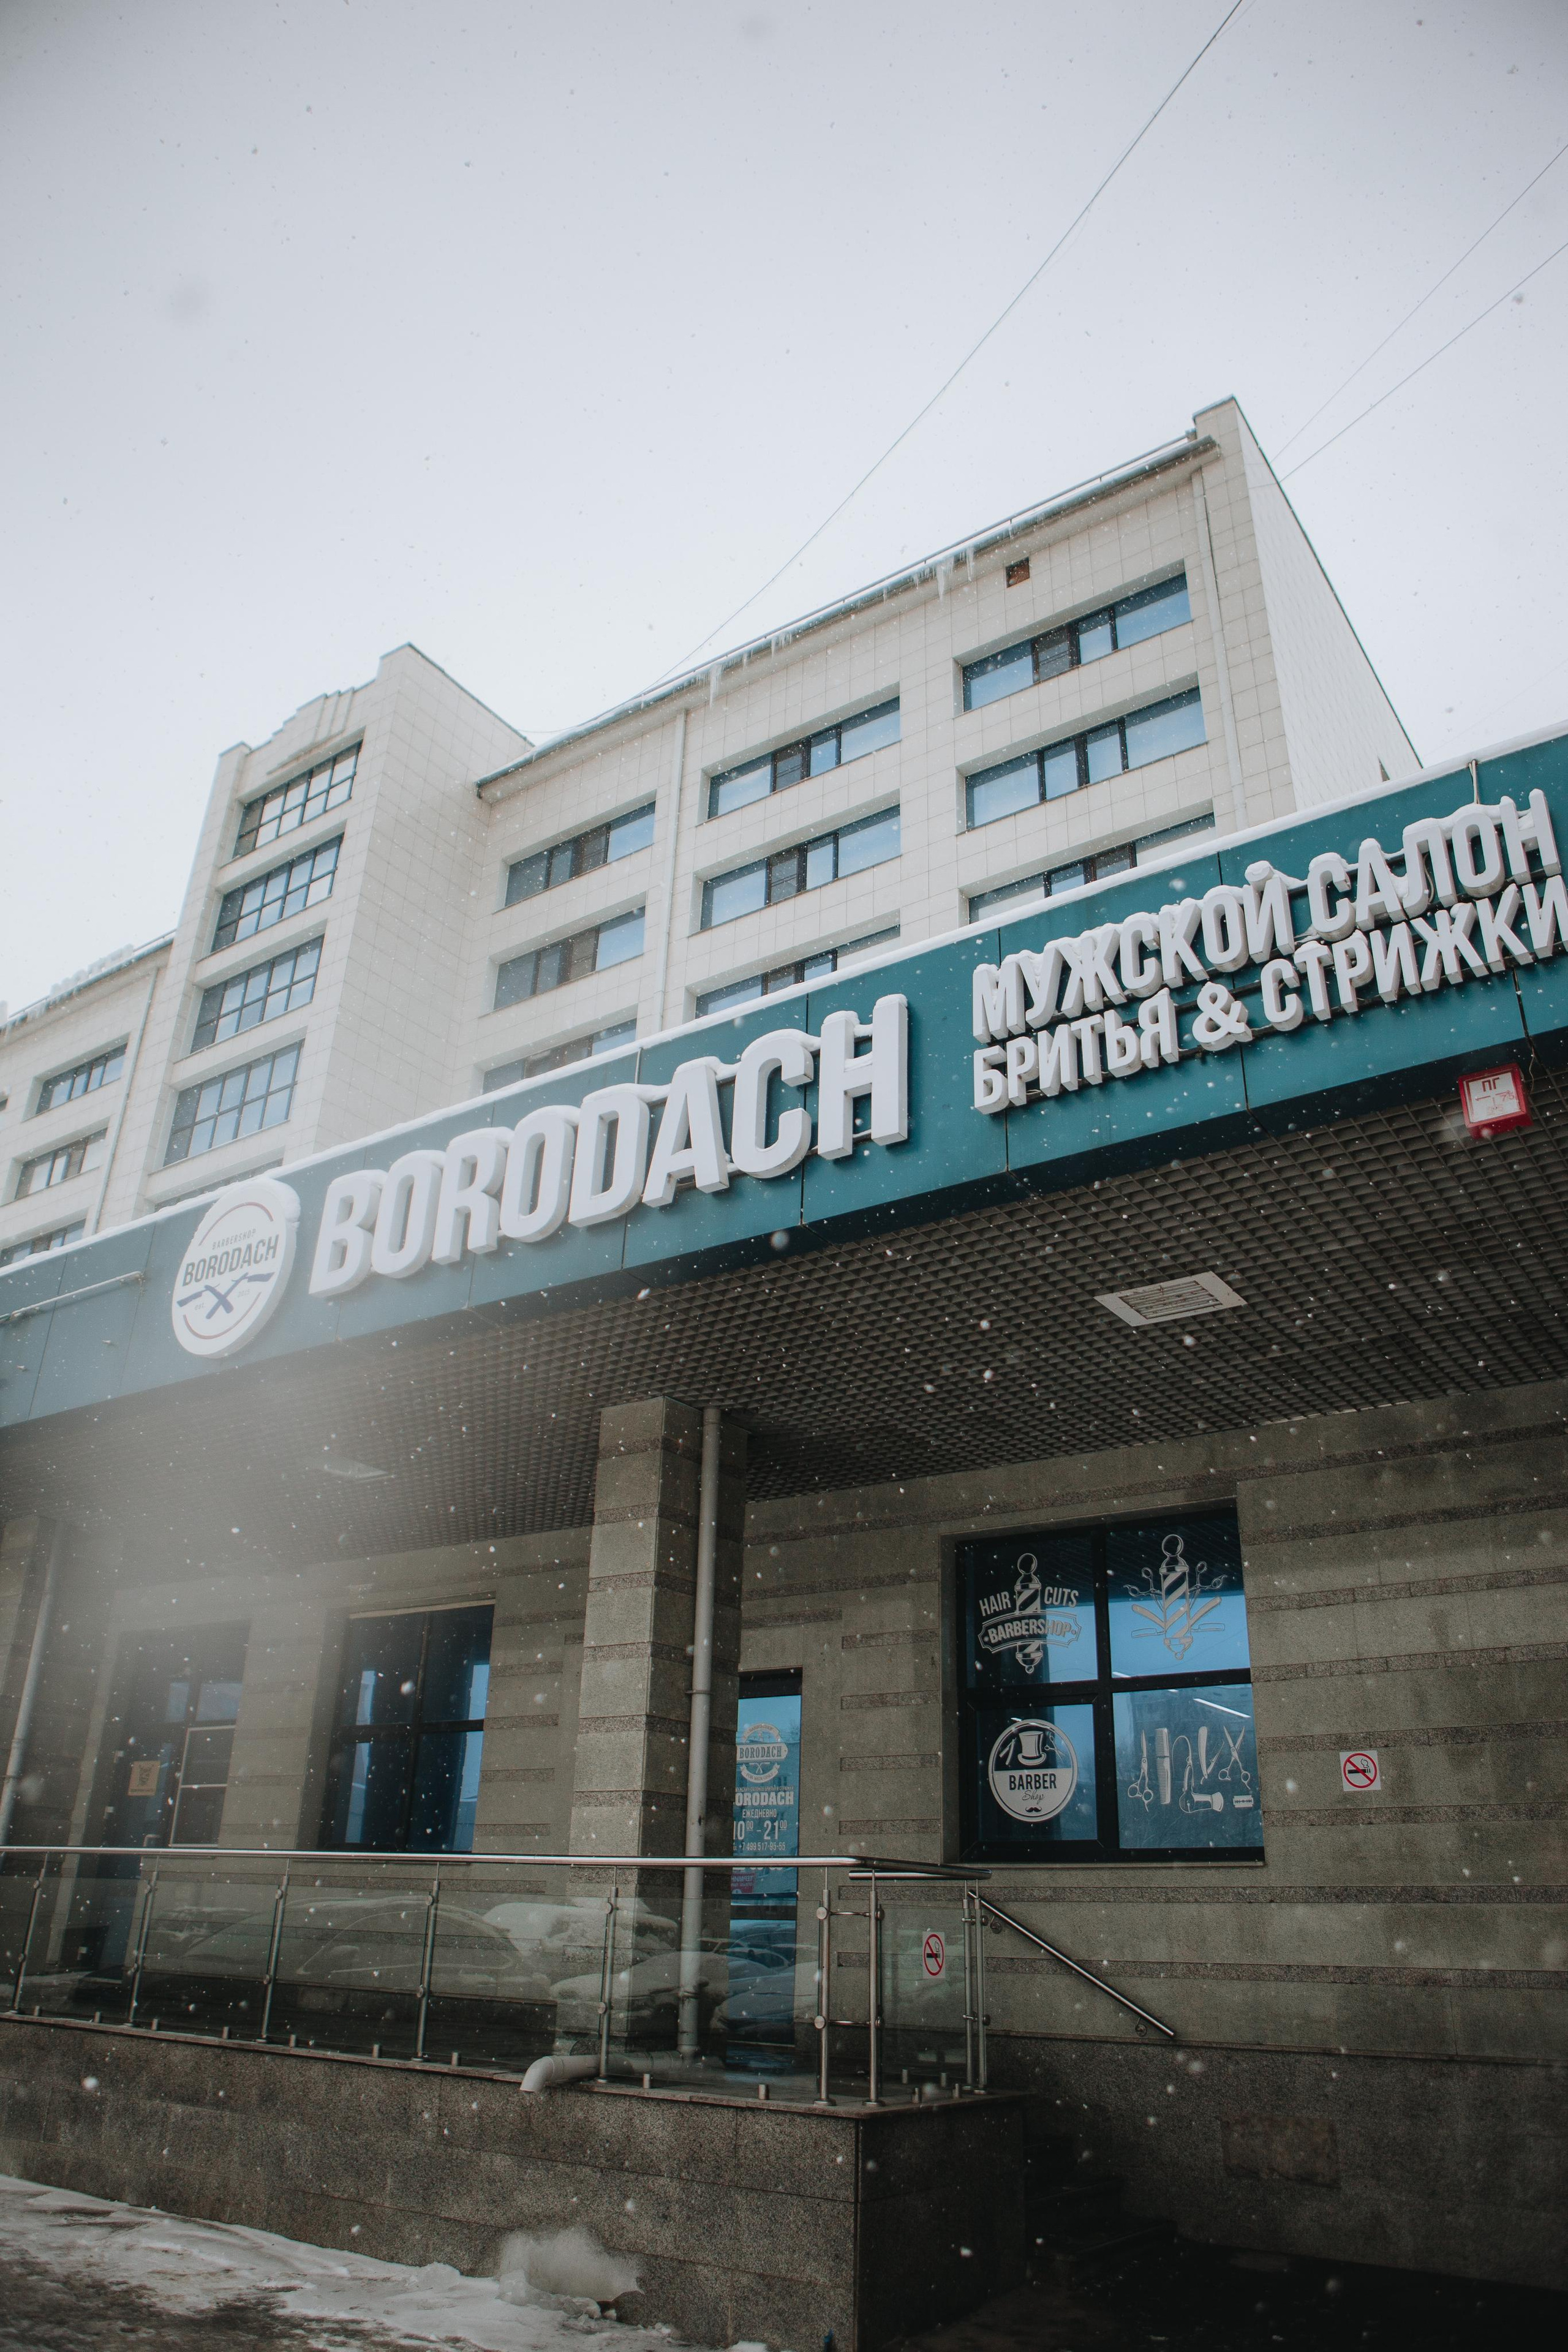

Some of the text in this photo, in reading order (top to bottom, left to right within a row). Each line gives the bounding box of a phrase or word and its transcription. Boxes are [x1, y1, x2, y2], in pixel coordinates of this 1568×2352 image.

[973, 788, 1561, 1043] МУЖСКОЙ САЛОН
[973, 875, 1568, 1115] БРИТЬЯ & СТРИЖКИ
[1482, 1077, 1499, 1091] ПГ
[309, 993, 908, 1298] BORODACH
[212, 1228, 257, 1250] BARBERSHOP
[182, 1234, 279, 1287] BORODACH
[979, 1586, 1079, 1616] HAIR CUTS
[987, 1618, 1071, 1644] BARBERSHOP
[739, 1746, 782, 1758] BORODACH
[1009, 1773, 1057, 1791] BARBER
[734, 1791, 794, 1806] ORODACH
[1021, 1789, 1045, 1806] Shop
[742, 1809, 777, 1819] ЕЖЕДНЕВНО
